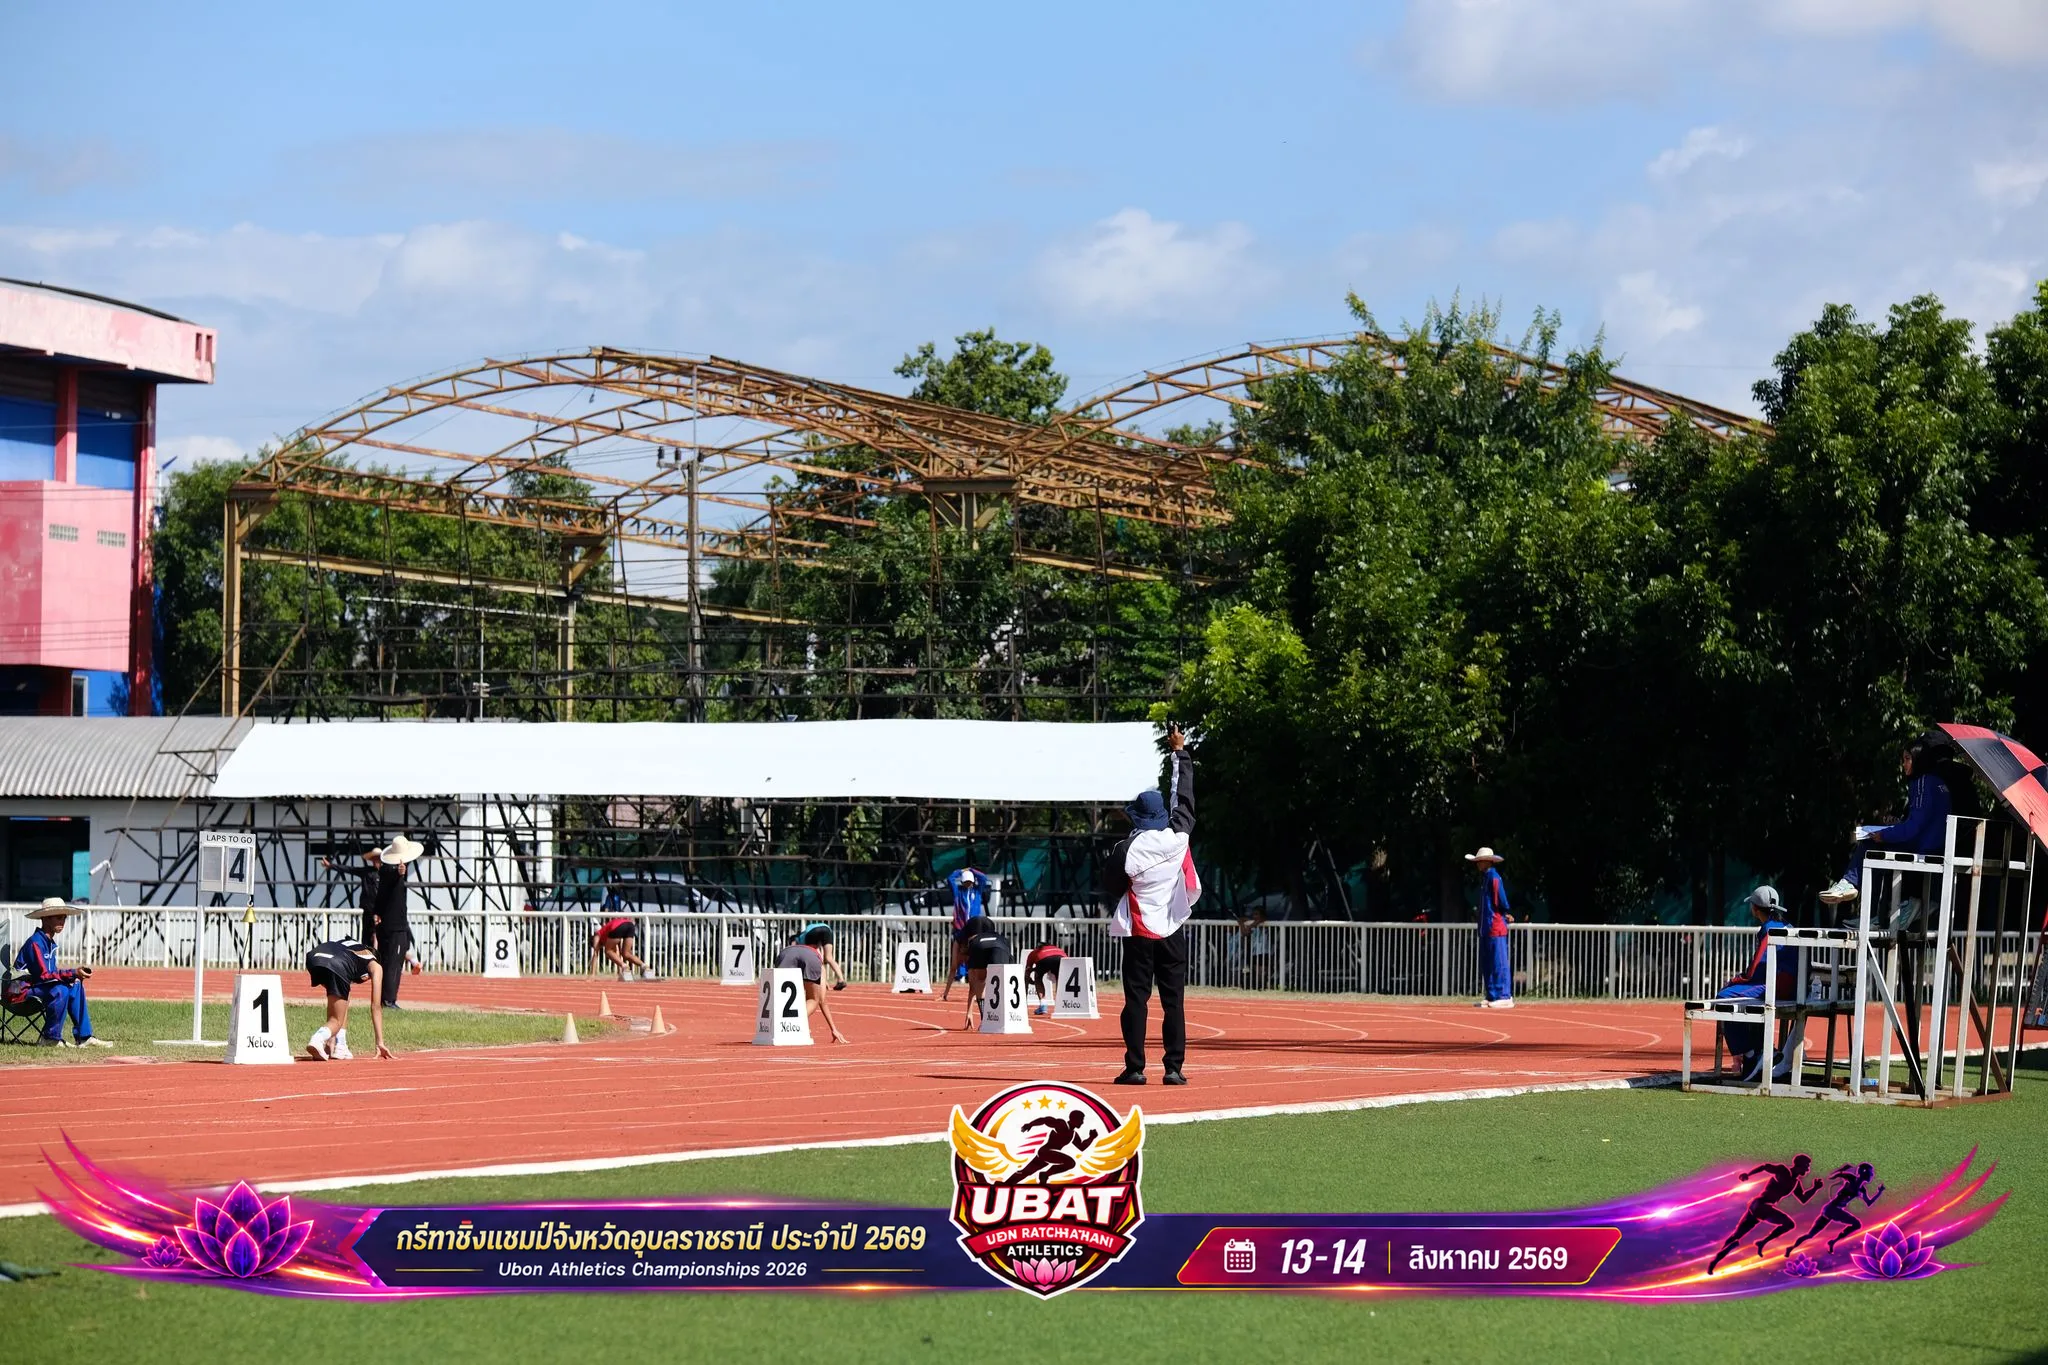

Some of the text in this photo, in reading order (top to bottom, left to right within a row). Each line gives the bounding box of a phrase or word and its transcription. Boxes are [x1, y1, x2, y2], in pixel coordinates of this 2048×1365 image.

[206, 834, 227, 842] LAPS
[229, 848, 245, 882] 4
[495, 939, 509, 960] 8
[731, 945, 745, 968] 7
[904, 949, 920, 974] 6
[989, 975, 1000, 1009] 3
[1009, 975, 1020, 1009] 3
[1065, 967, 1081, 998] 4
[253, 989, 269, 1033] 1
[761, 981, 771, 1018] 2
[781, 981, 799, 1018] 2
[247, 1036, 274, 1048] Nelco
[780, 1021, 801, 1032] Nelco
